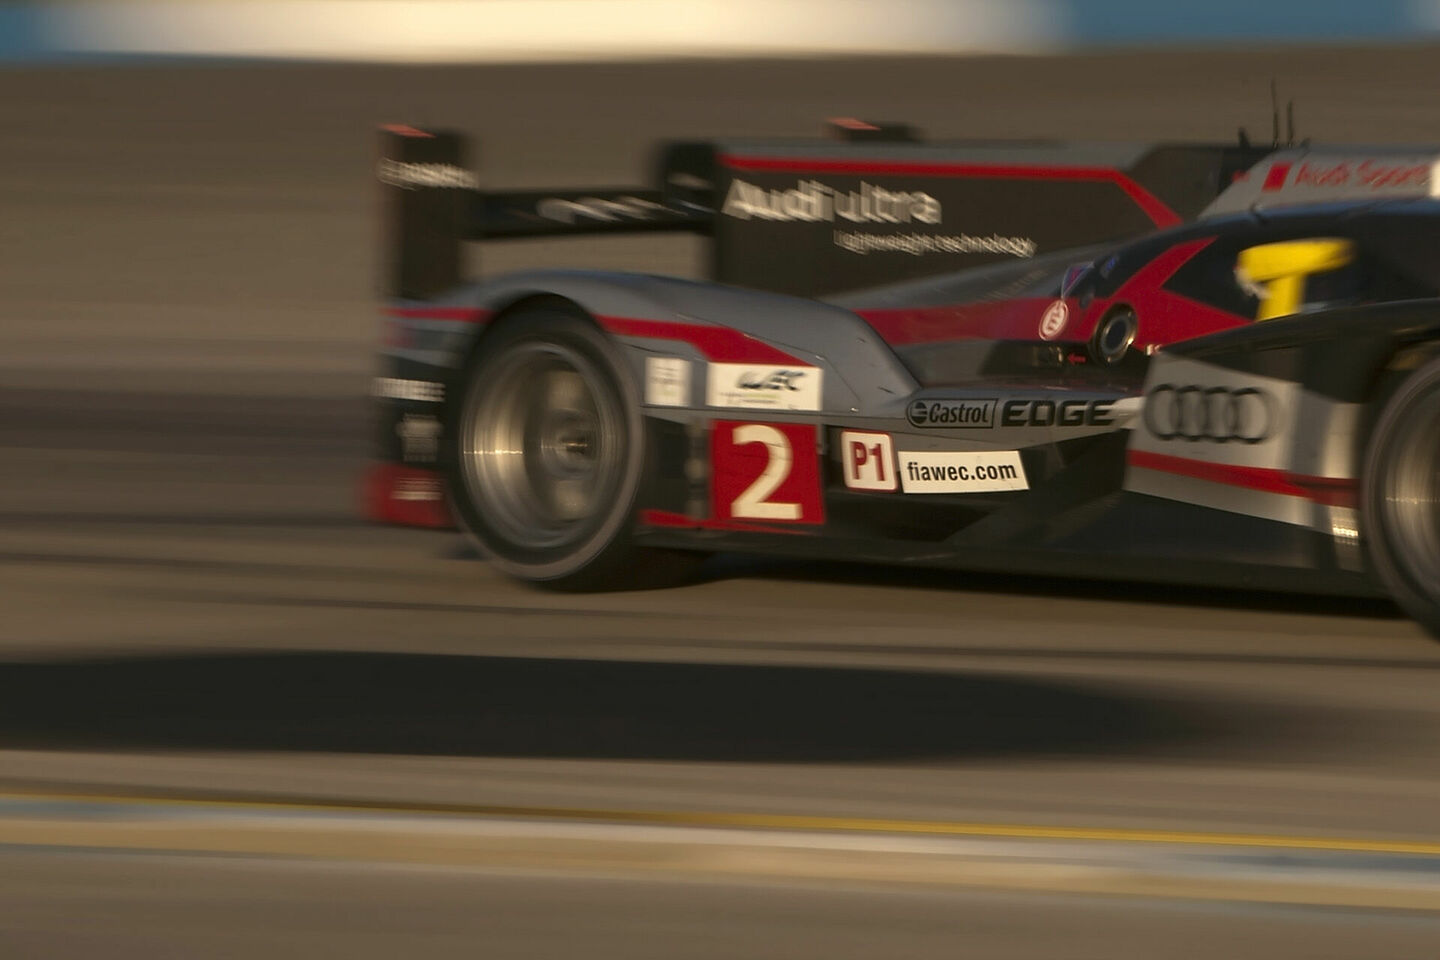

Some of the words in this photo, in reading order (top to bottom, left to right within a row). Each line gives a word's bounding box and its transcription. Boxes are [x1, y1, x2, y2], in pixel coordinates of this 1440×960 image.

[721, 178, 834, 222] Audi
[834, 180, 942, 224] ultra
[929, 401, 989, 425] Castrol
[1001, 399, 1117, 428] EDGE
[731, 424, 803, 520] 2
[850, 440, 887, 482] P1
[906, 460, 1018, 482] fiawec.com
